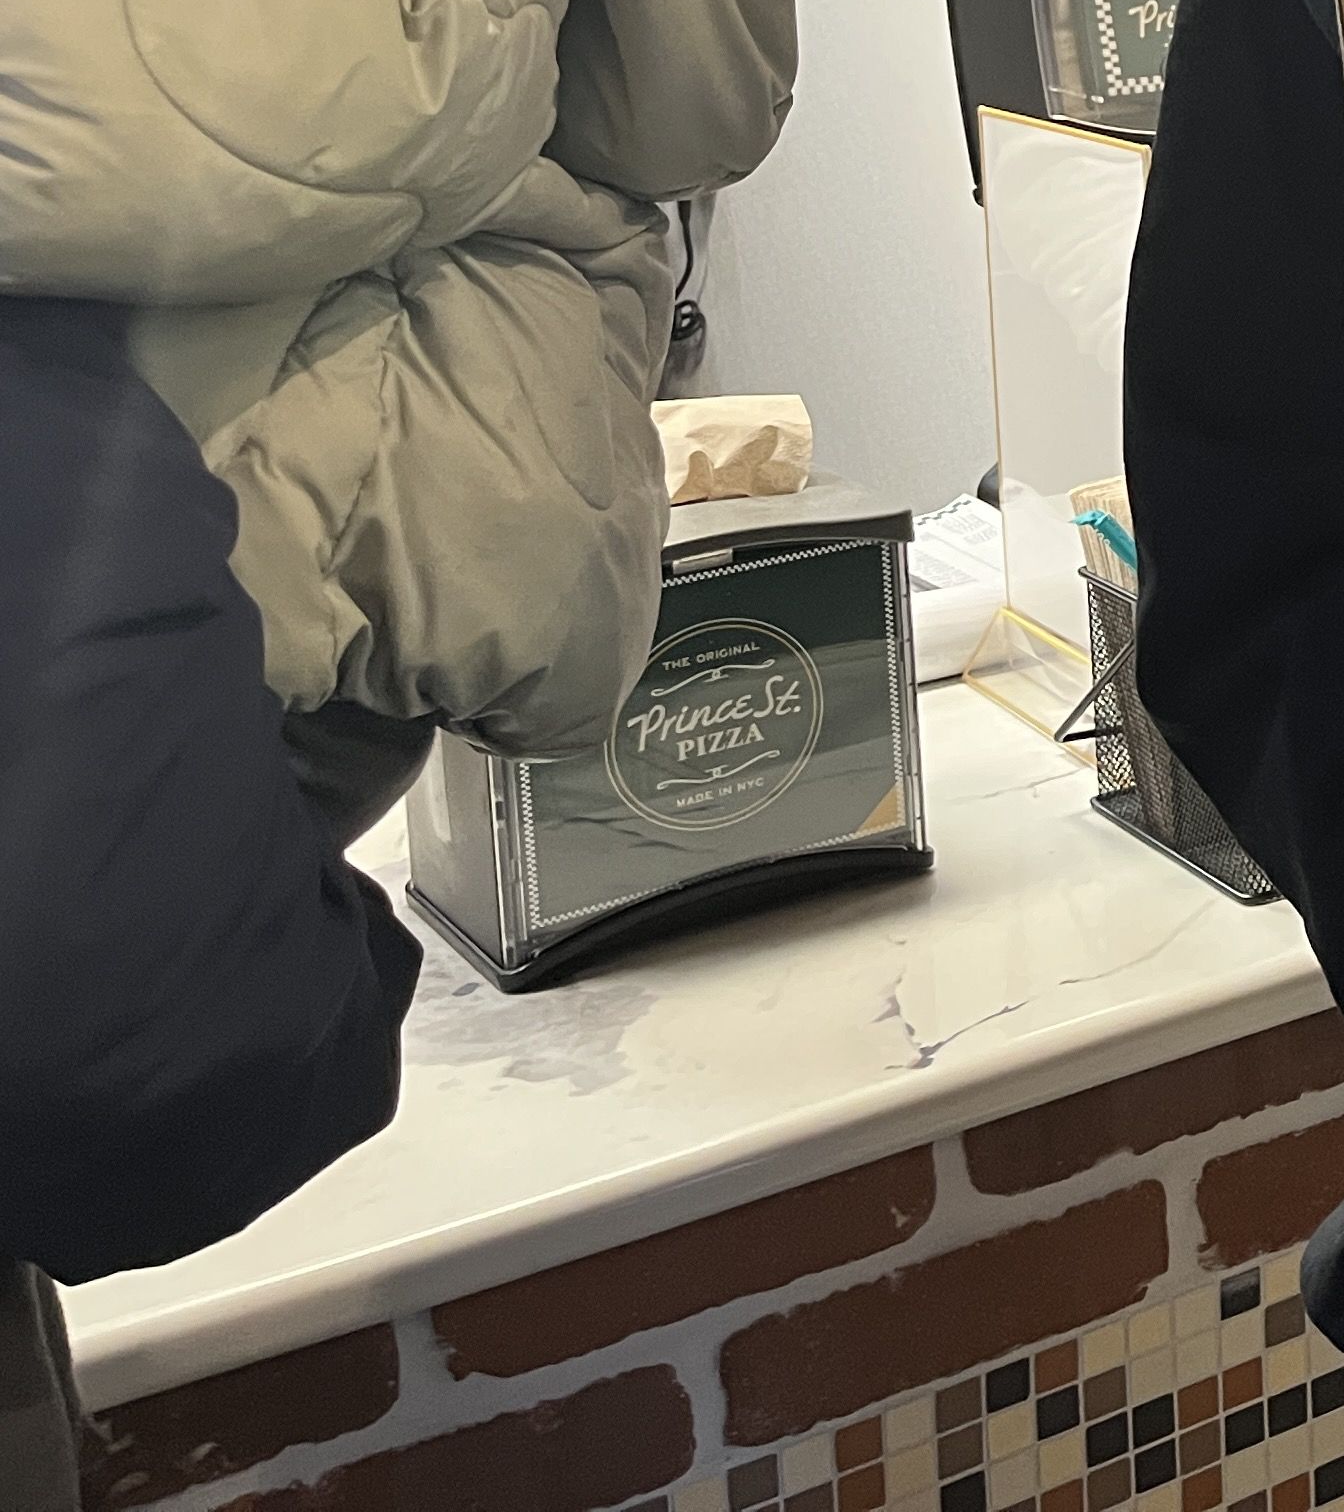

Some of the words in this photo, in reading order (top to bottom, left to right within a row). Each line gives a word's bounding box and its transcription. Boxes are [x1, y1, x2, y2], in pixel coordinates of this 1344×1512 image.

[1128, 0, 1176, 39] Pri
[661, 656, 691, 671] THE
[696, 641, 761, 664] ORIGINAL
[627, 694, 754, 753] Prince
[752, 675, 802, 719] St.
[676, 722, 765, 762] PIZZA
[676, 790, 714, 808] MADE
[718, 785, 733, 797] IN
[736, 777, 765, 792] NYC
